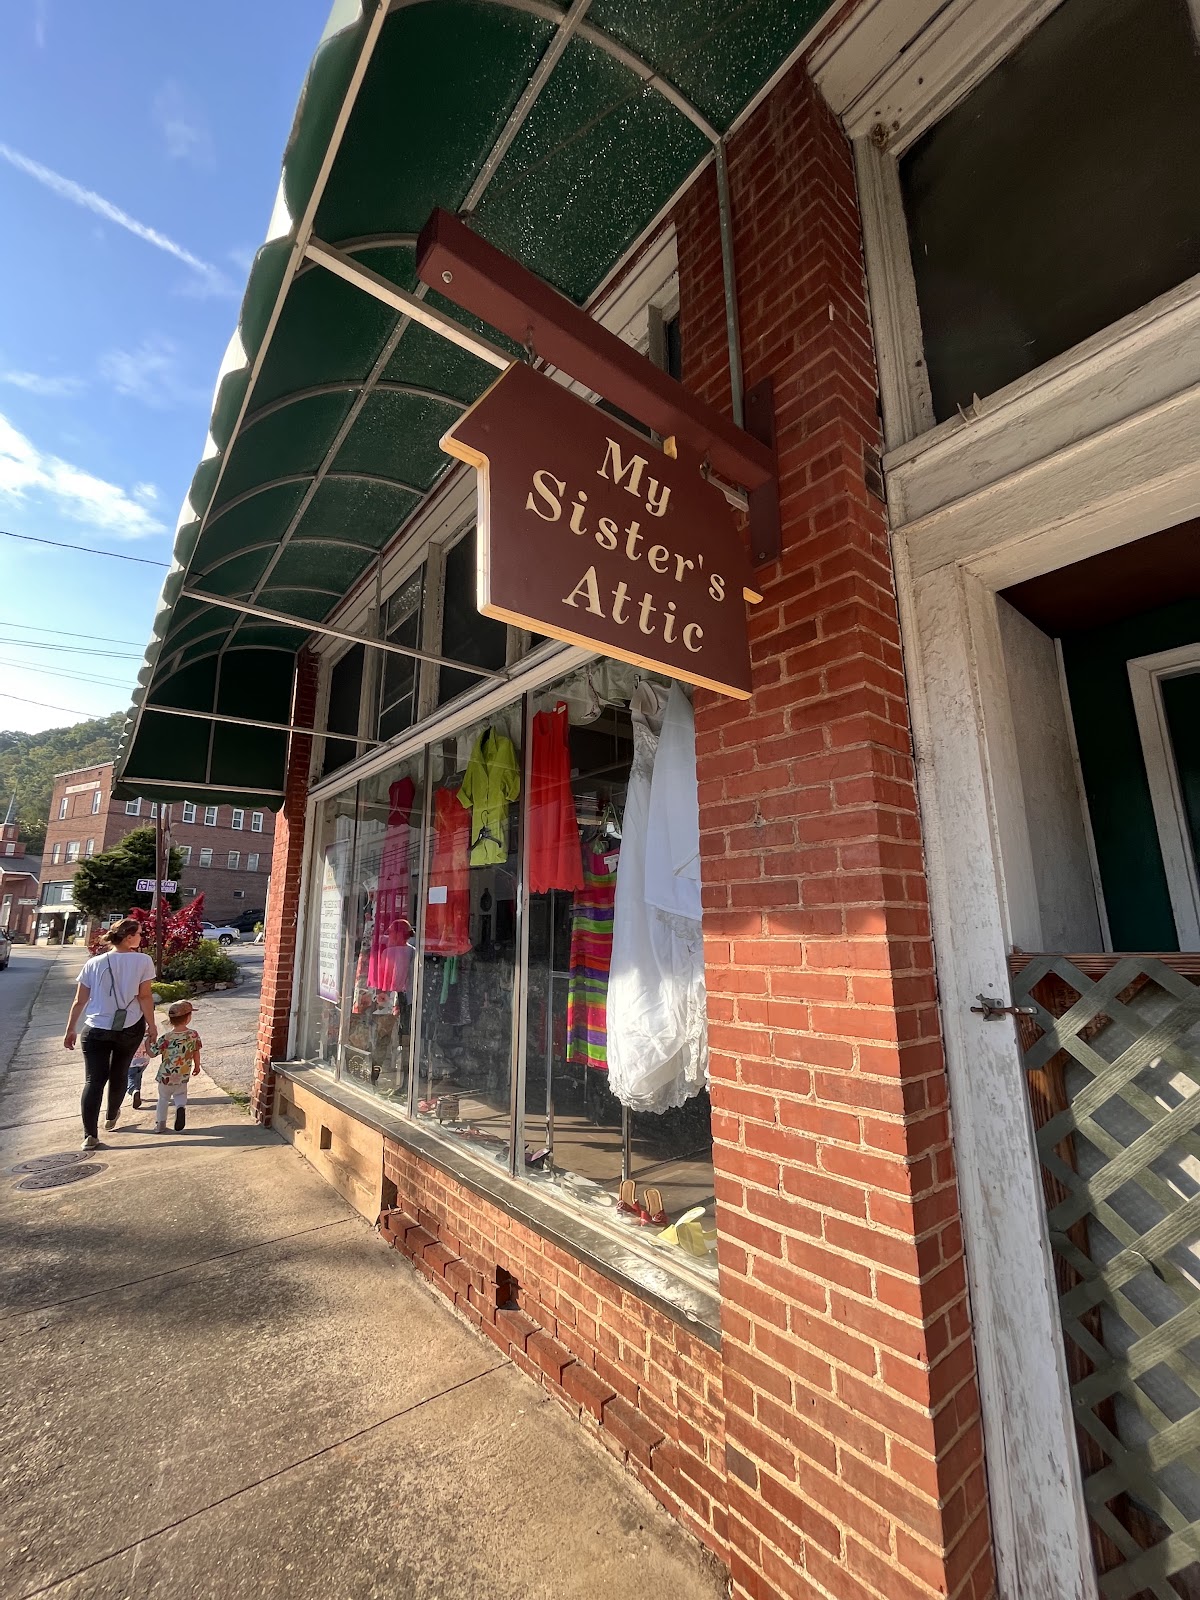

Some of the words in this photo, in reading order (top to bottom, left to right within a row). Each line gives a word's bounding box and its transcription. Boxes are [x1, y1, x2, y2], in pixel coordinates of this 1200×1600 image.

[596, 436, 672, 517] My
[525, 469, 725, 602] Sister's
[562, 565, 704, 653] Attic
